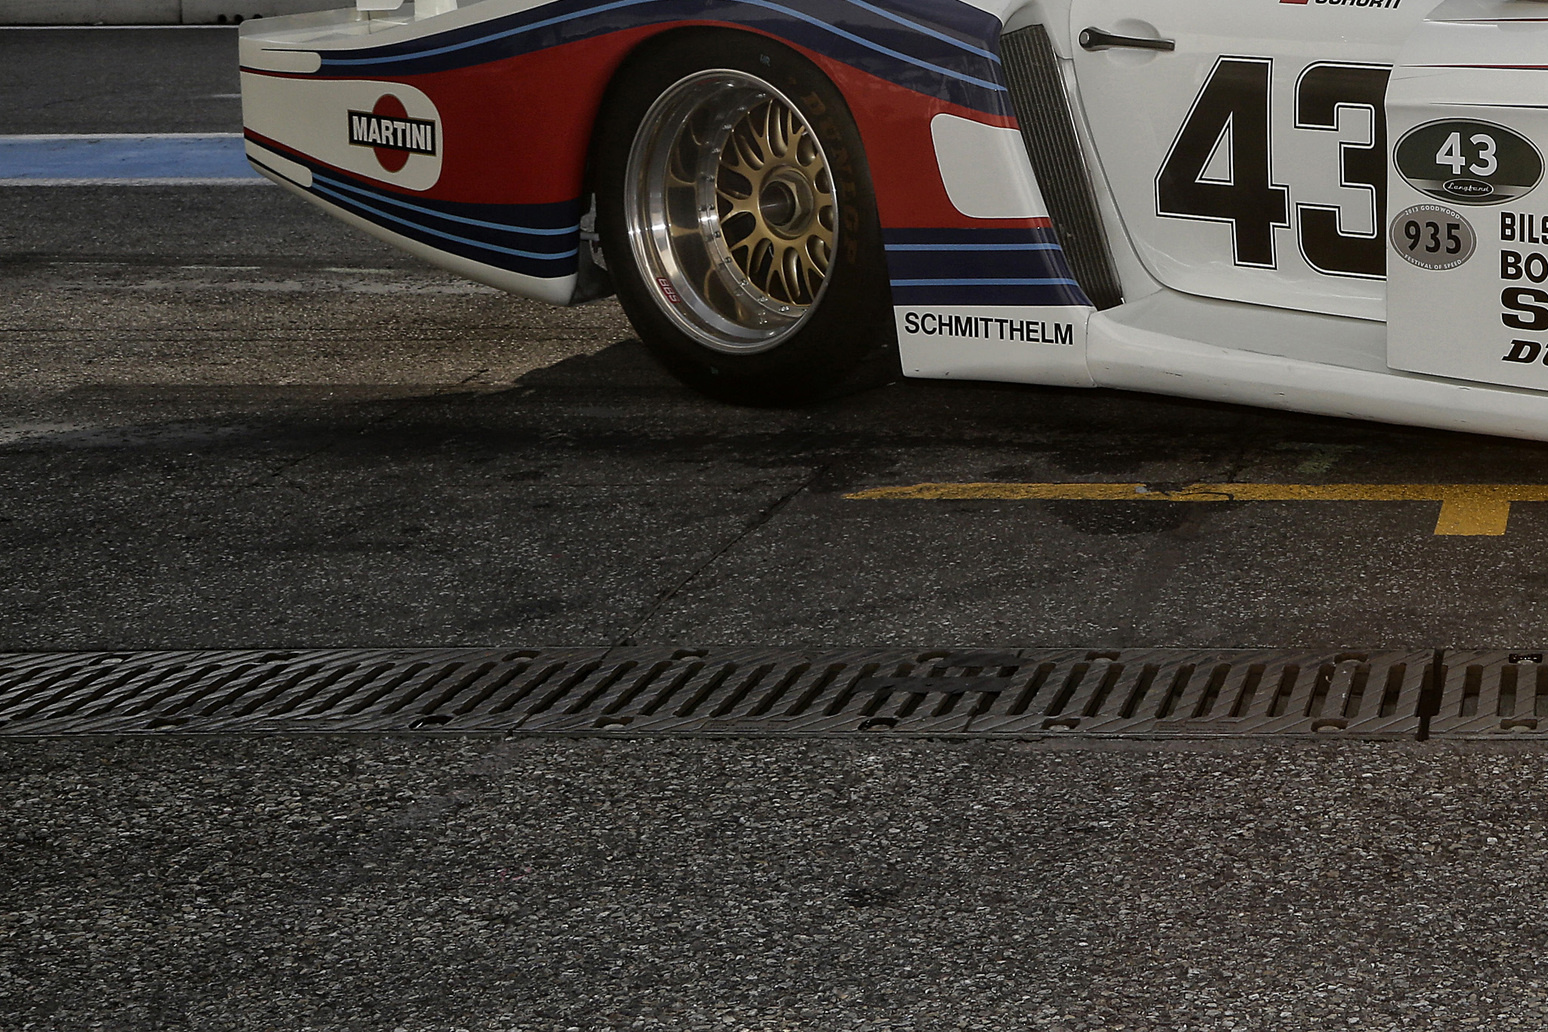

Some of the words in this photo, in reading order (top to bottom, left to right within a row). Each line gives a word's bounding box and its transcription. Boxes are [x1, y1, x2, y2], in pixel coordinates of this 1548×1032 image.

[352, 115, 432, 151] MARTINI
[1154, 54, 1393, 281] 43
[1435, 131, 1498, 176] 43
[1420, 205, 1461, 220] GOODWOOD
[1404, 220, 1462, 254] 935
[1403, 253, 1433, 270] FESTIVAL
[1443, 259, 1462, 269] SPEED
[905, 311, 1074, 345] SCHMITTHELM
